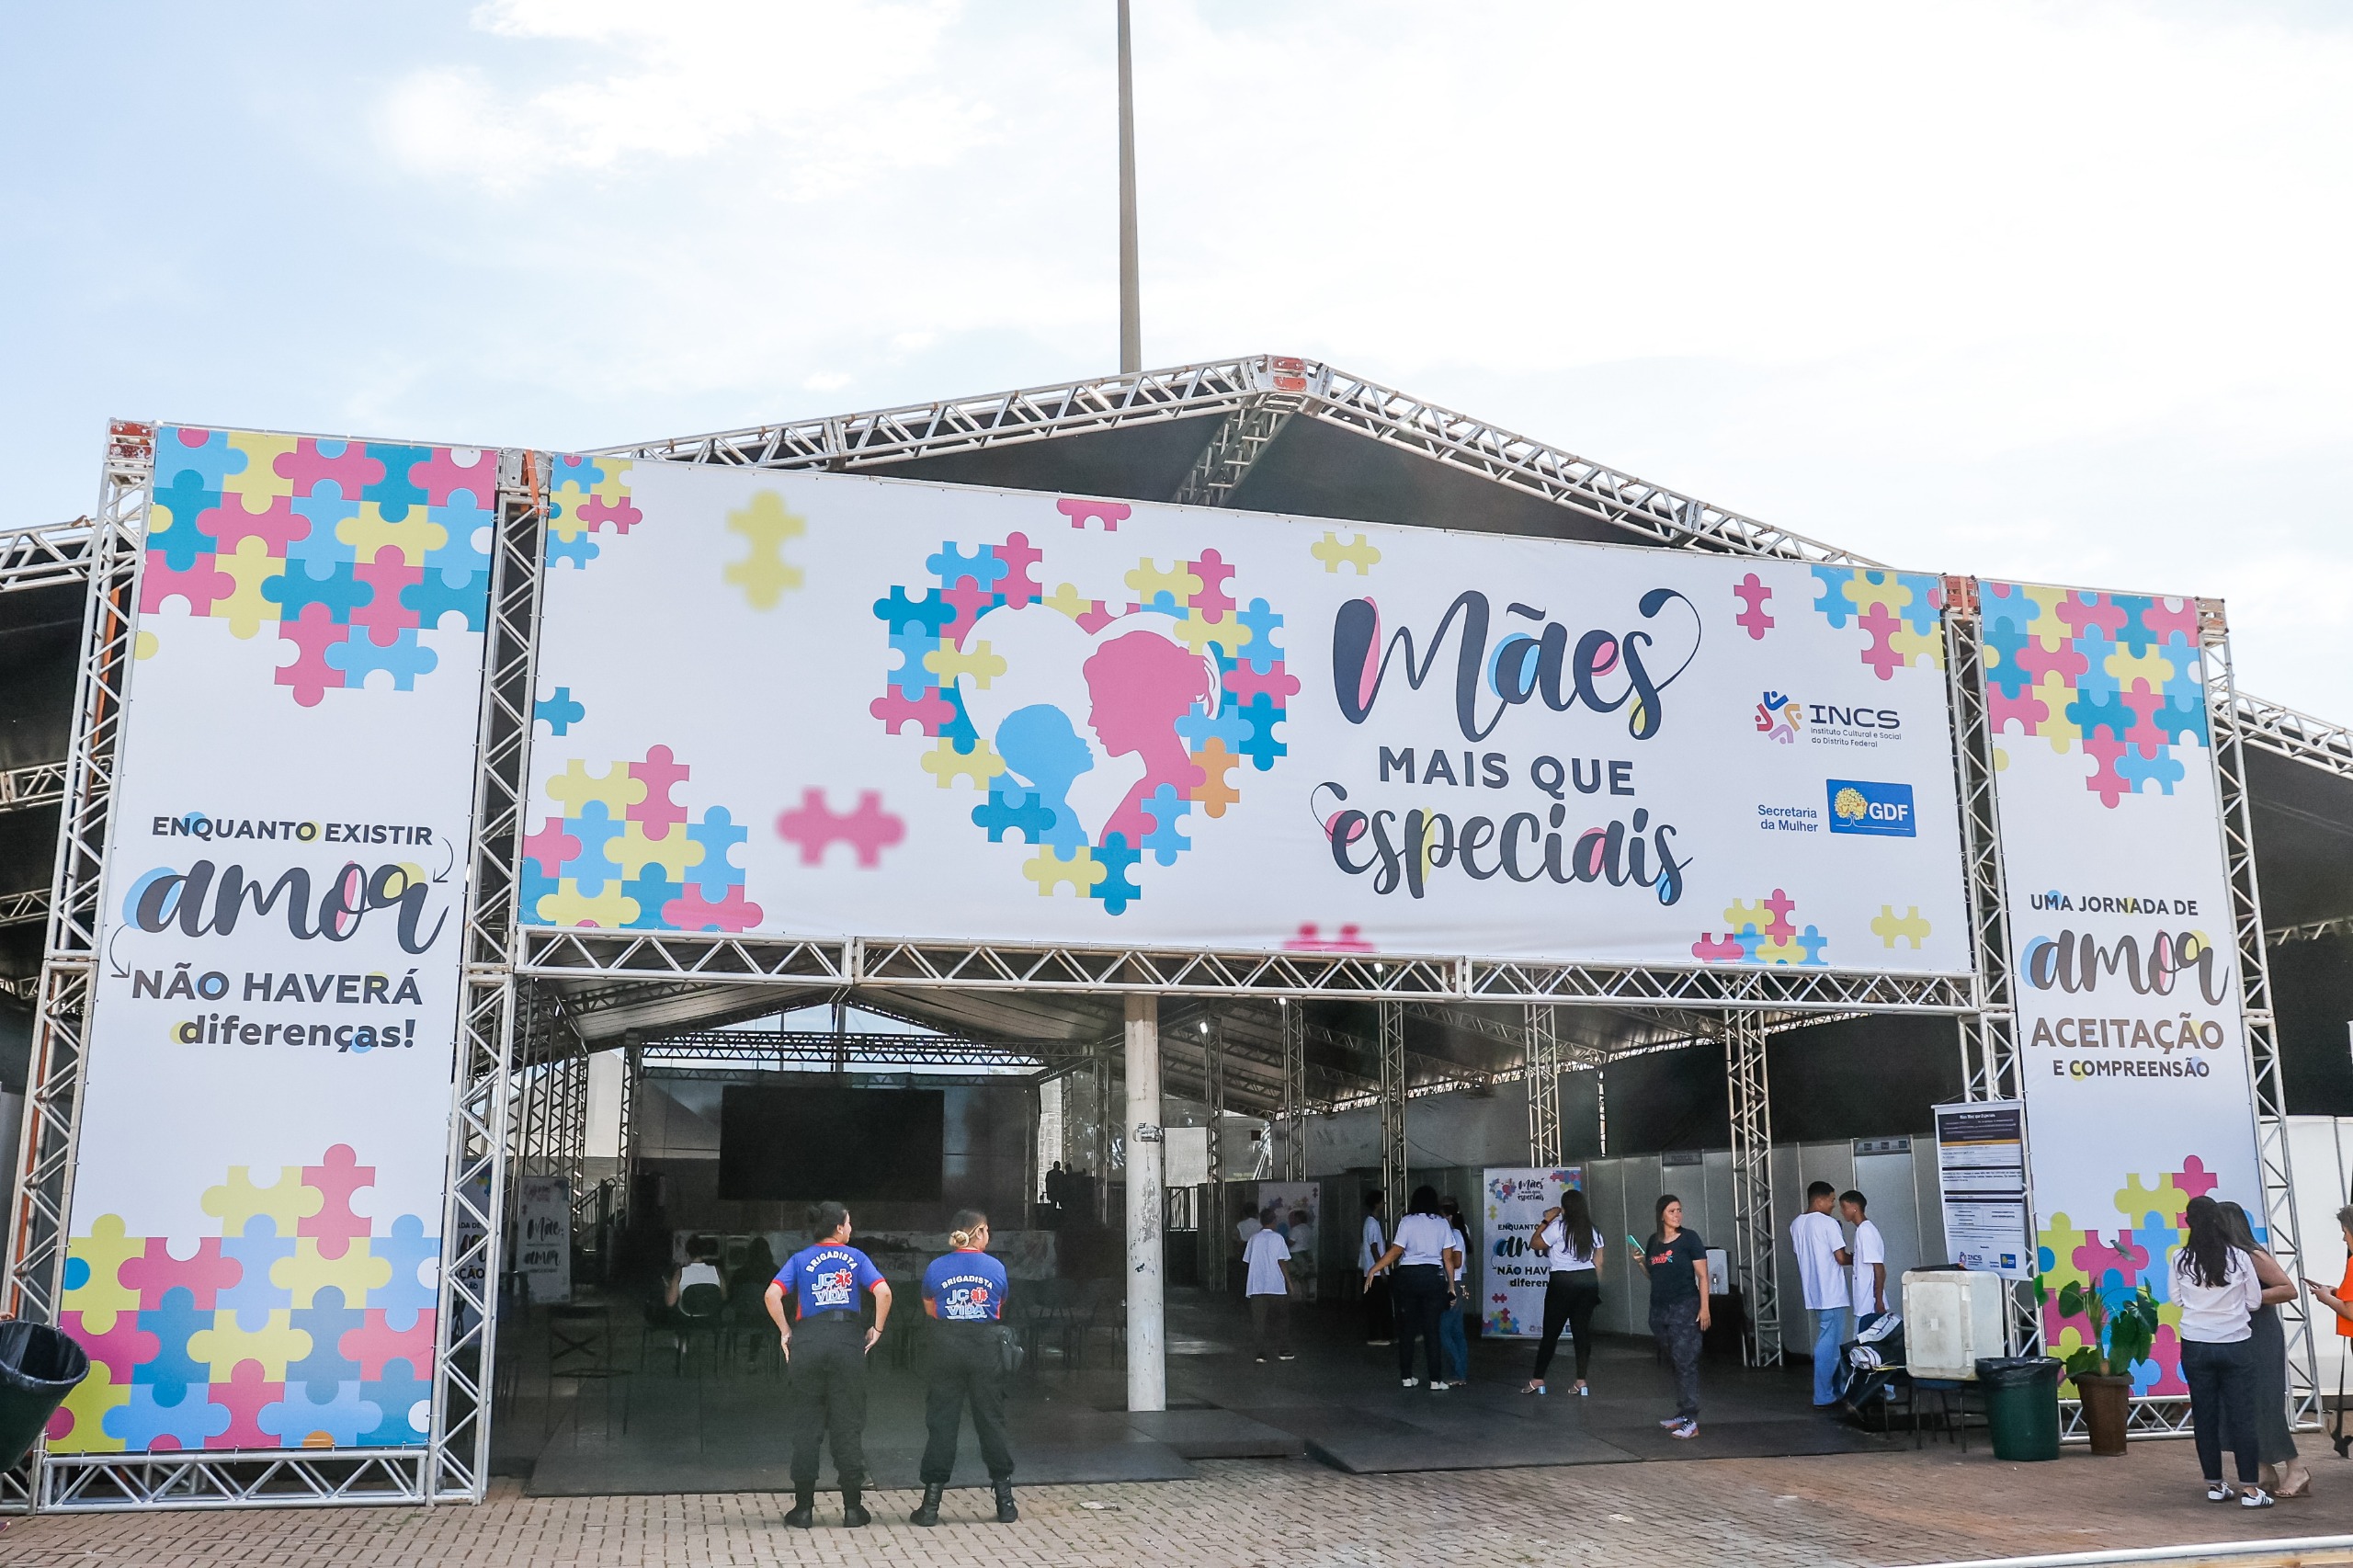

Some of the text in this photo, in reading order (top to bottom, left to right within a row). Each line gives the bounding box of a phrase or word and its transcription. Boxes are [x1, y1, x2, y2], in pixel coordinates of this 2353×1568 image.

[1333, 587, 1701, 743] Mães
[1809, 704, 1901, 730] INCS
[1811, 727, 1841, 736] Instituto
[1842, 729, 1872, 739] Cultural
[1880, 731, 1902, 741] Social
[1812, 736, 1878, 748] do Distrito Federal
[1379, 745, 1636, 801] MAIS QUE
[1757, 804, 1818, 819] Secretaria
[1869, 801, 1909, 822] GDF
[152, 816, 433, 846] ENQUANTO EXISTIR
[1760, 818, 1818, 833] da Mulher
[1311, 781, 1693, 906] especiais
[136, 859, 449, 955] amor
[2030, 894, 2199, 916] UMA JORNADA DE
[2030, 928, 2229, 1006] amor
[132, 962, 423, 1006] NÃO HAVERÁ
[179, 1013, 416, 1053] diferenças!
[2030, 1012, 2223, 1055] ACEITAÇÃO
[2052, 1057, 2210, 1077] E COMPREENSÃO
[805, 1251, 858, 1273] BRIGADISTA
[1497, 1265, 1522, 1275] NÃO
[812, 1273, 835, 1291] JC
[941, 1275, 993, 1290] BRIGADISTA
[812, 1289, 849, 1302] VIDA
[947, 1289, 970, 1305] JC
[945, 1305, 986, 1316] VIDA
